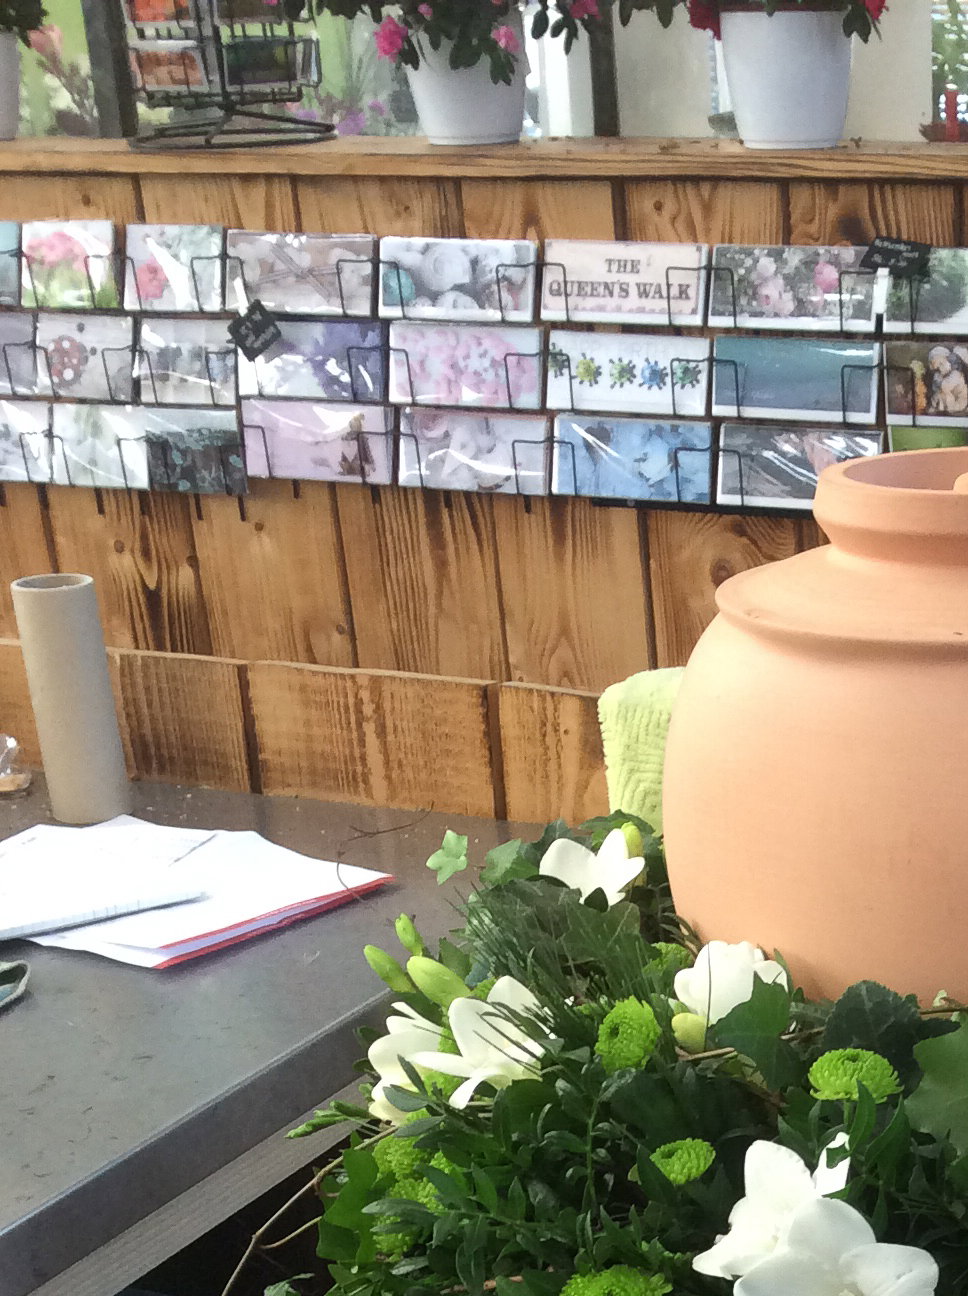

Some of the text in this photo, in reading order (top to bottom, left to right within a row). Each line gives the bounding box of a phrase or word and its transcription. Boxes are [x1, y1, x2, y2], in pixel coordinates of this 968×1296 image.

[605, 258, 641, 274] THE
[548, 279, 692, 301] QUEEN'S WALK
